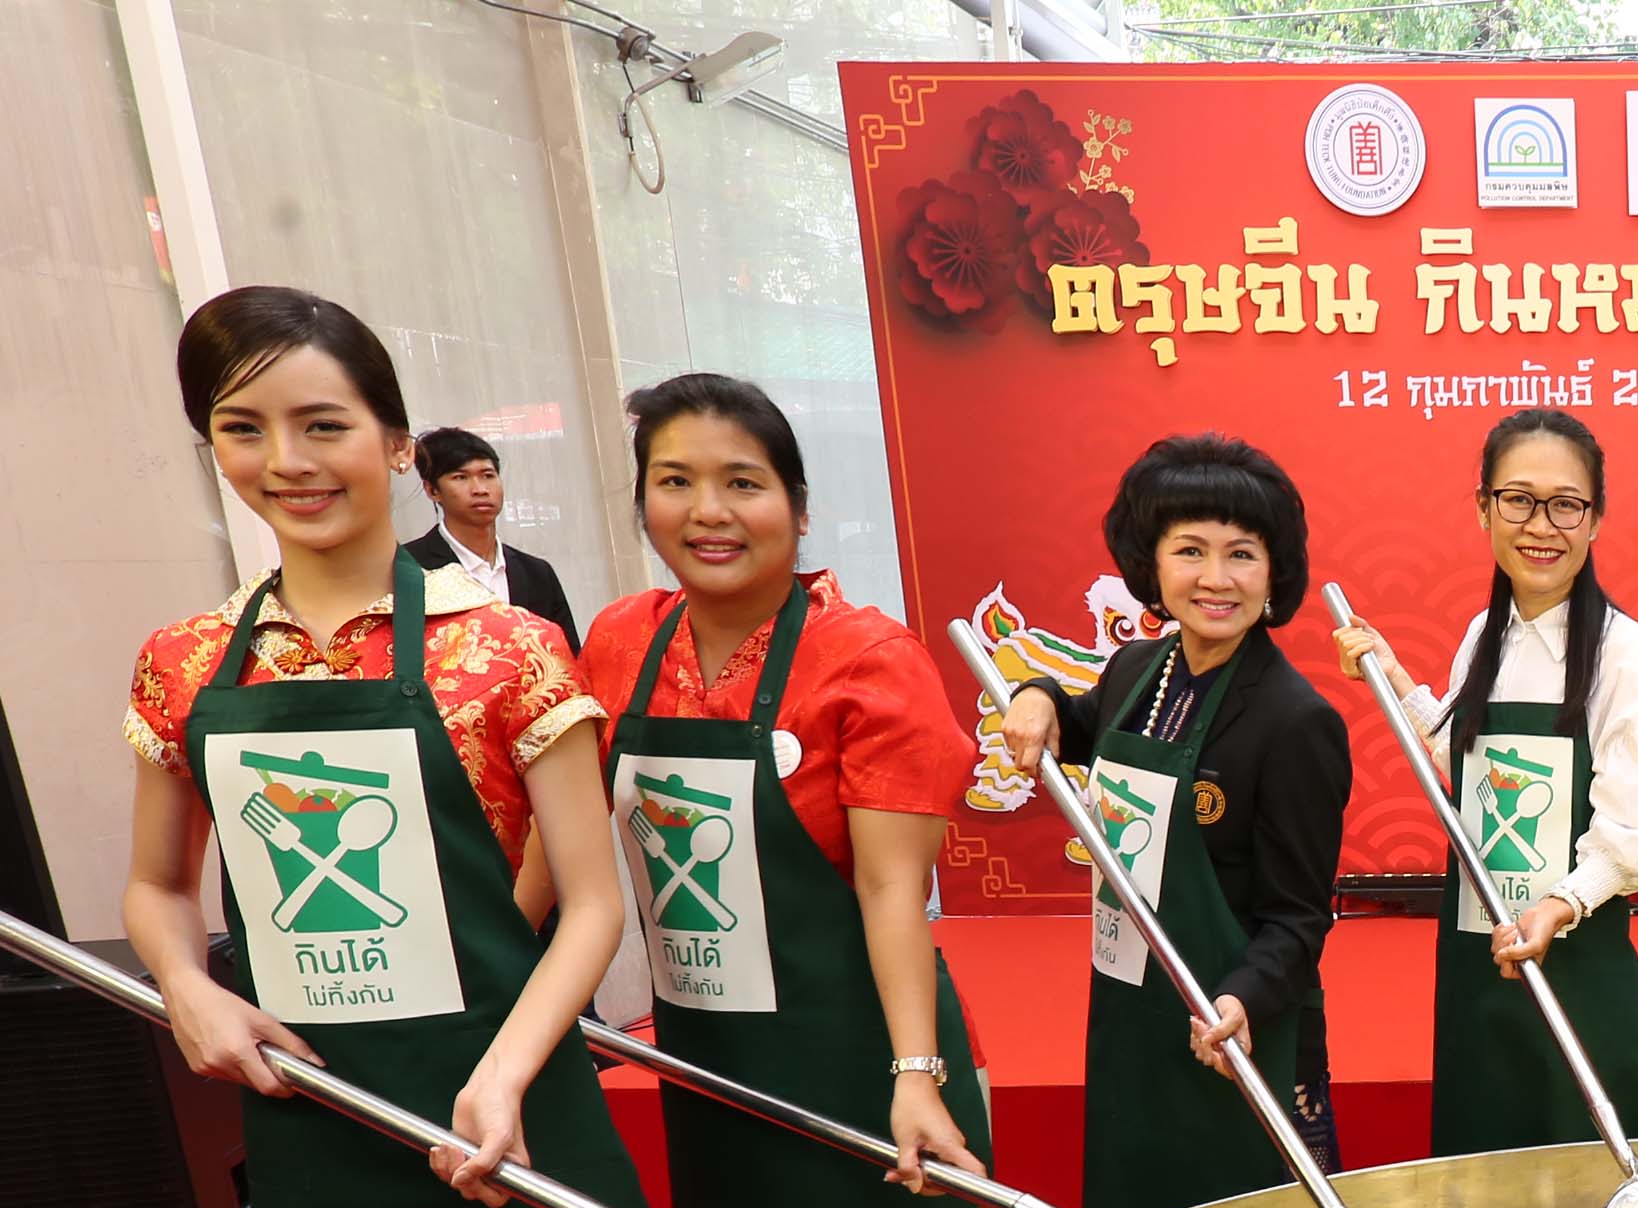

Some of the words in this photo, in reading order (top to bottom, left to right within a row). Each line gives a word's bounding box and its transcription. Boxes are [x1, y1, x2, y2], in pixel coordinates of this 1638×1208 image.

[1047, 217, 1380, 367] ตรุษจีน
[1333, 369, 1389, 408] 12
[1405, 358, 1595, 420] กุมภาพันธ์
[294, 936, 388, 974] กินได้
[662, 937, 721, 968] กินได้
[302, 980, 394, 1007] ไม่ทิ้งกัน
